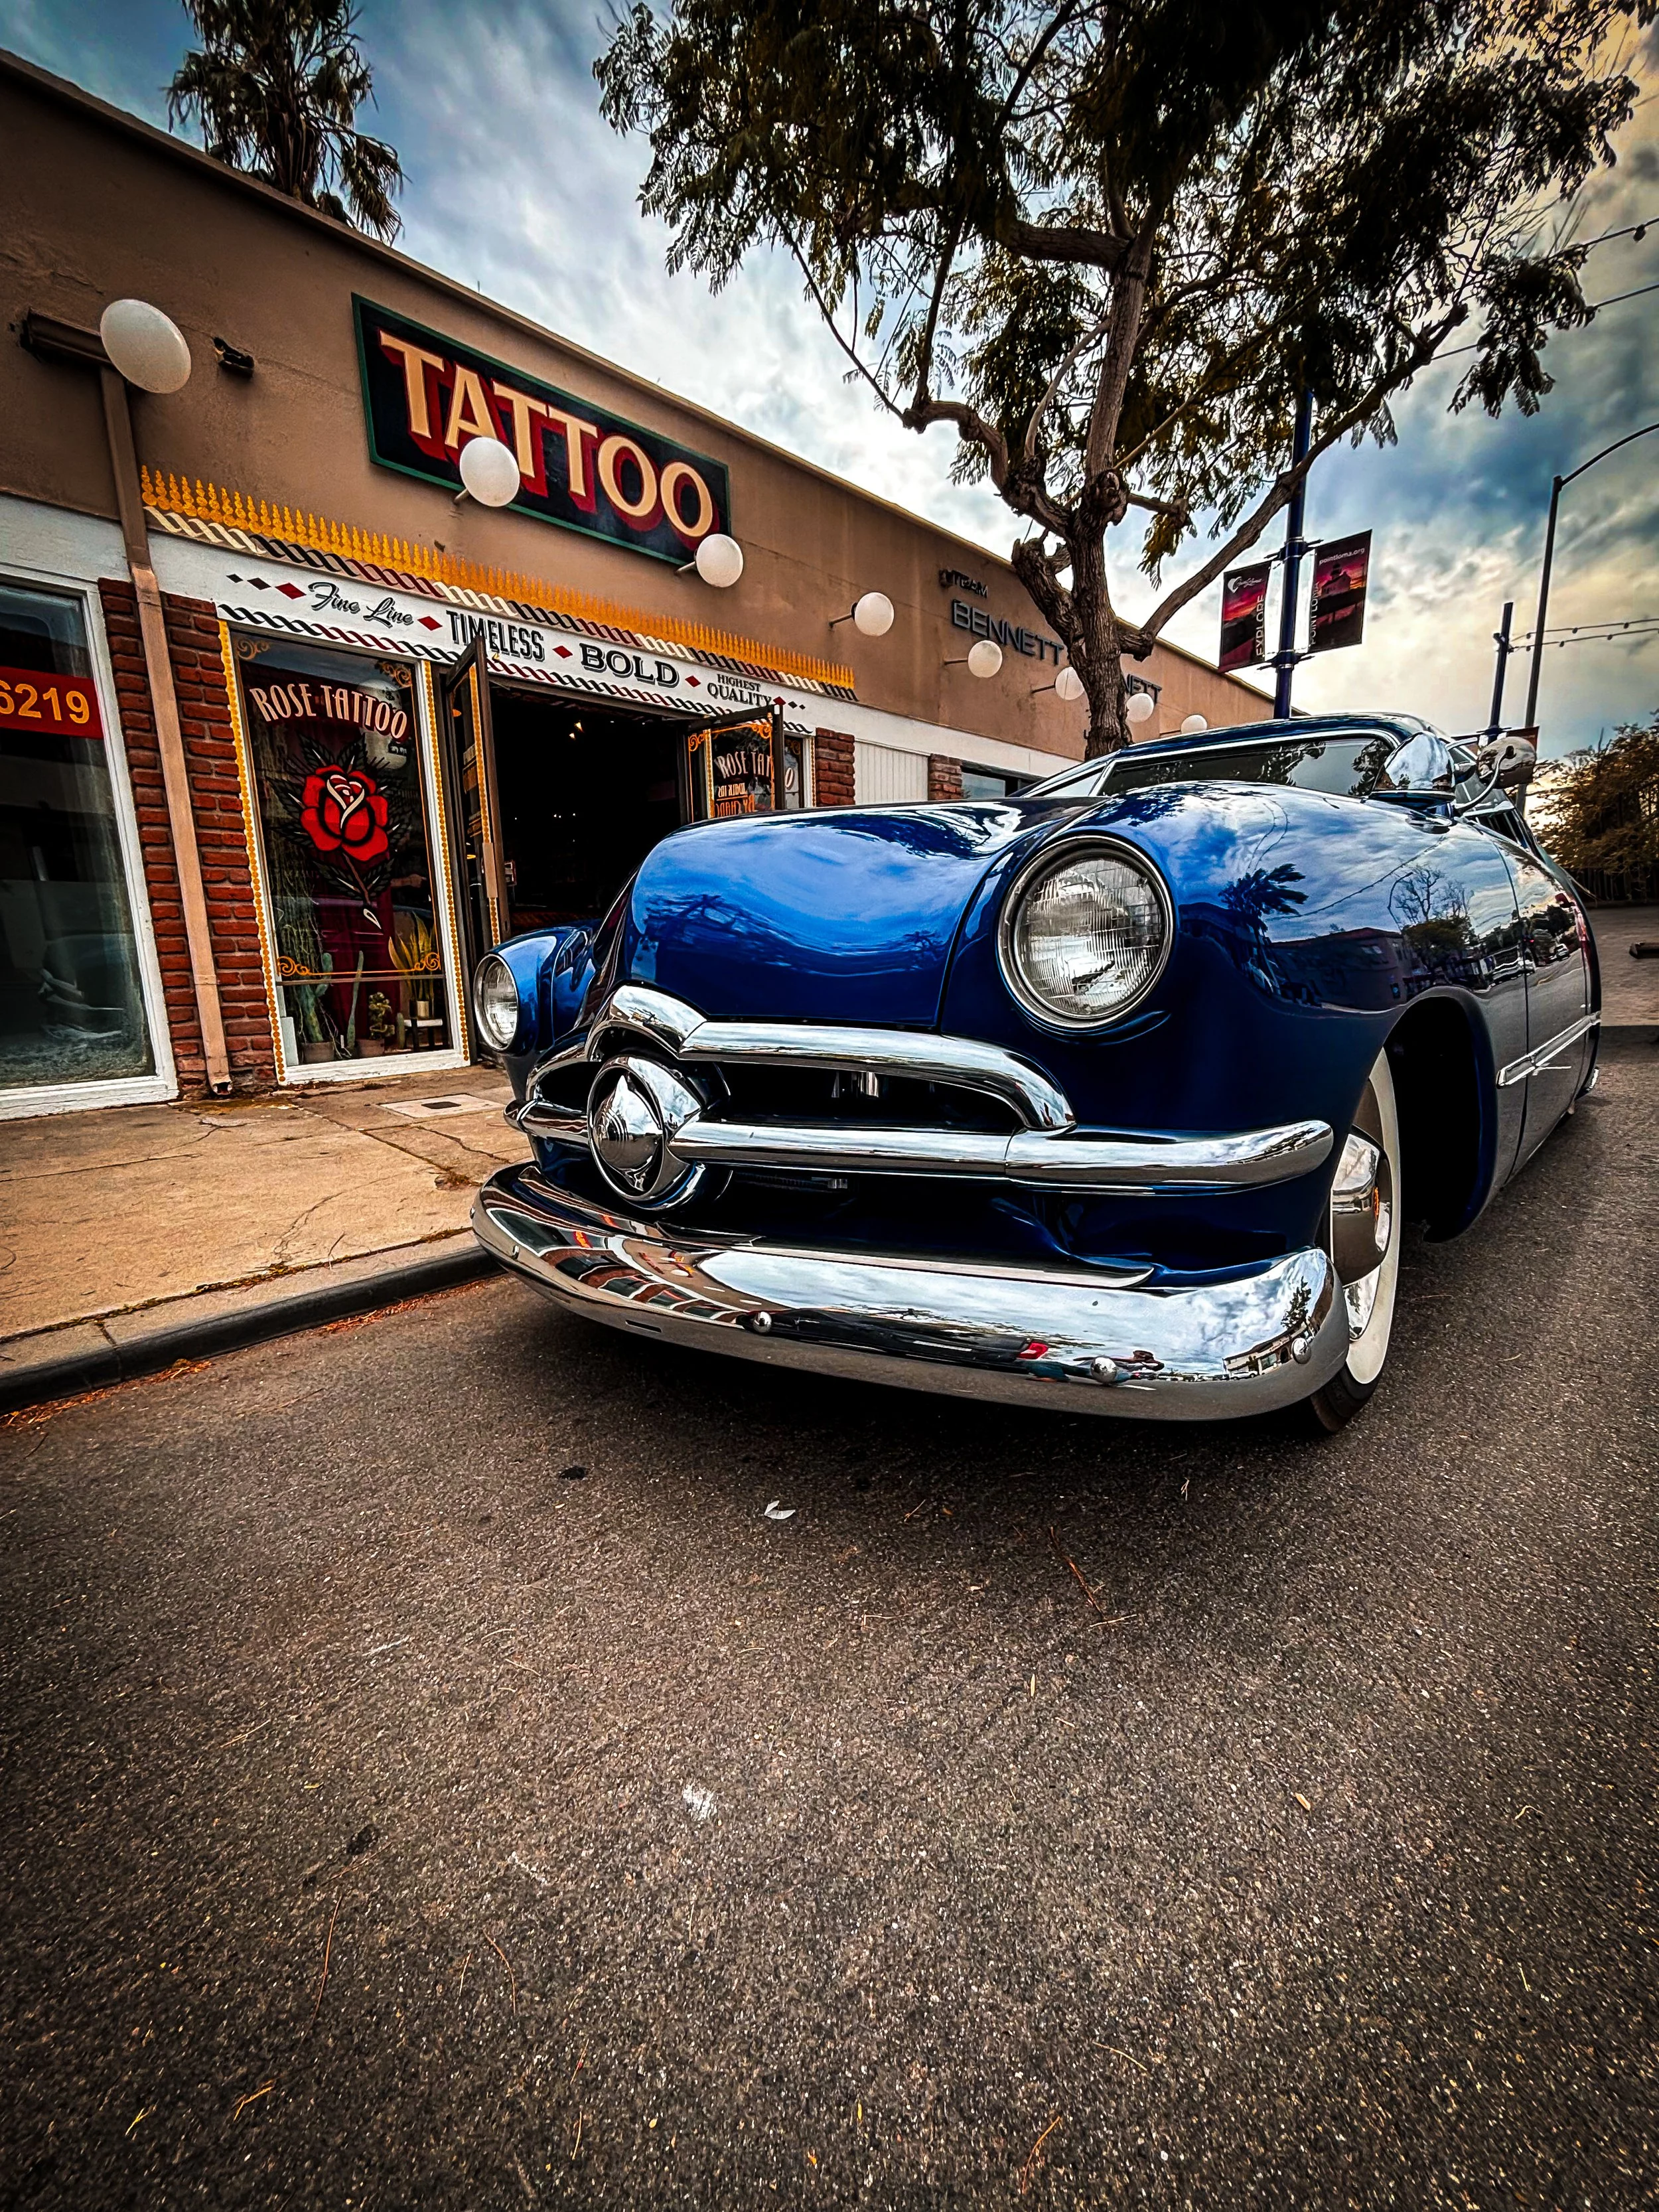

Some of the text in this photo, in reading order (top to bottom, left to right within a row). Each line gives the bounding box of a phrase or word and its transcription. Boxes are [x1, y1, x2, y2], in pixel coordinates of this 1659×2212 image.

[379, 329, 714, 538] TATTOO
[1319, 548, 1365, 565] pointloma.org
[308, 581, 413, 628] Fine Line
[1256, 595, 1264, 656] EXPLORE
[446, 610, 545, 662] TIMELESS
[952, 599, 1064, 665] BENNETT
[579, 642, 679, 688] BOLD
[717, 674, 761, 692] HIGHEST
[0, 680, 90, 723] 6219
[250, 684, 407, 739] ROSE TATTOO
[707, 683, 772, 707] QUALITY
[1121, 674, 1162, 705] NETT
[717, 751, 748, 778] ROSE
